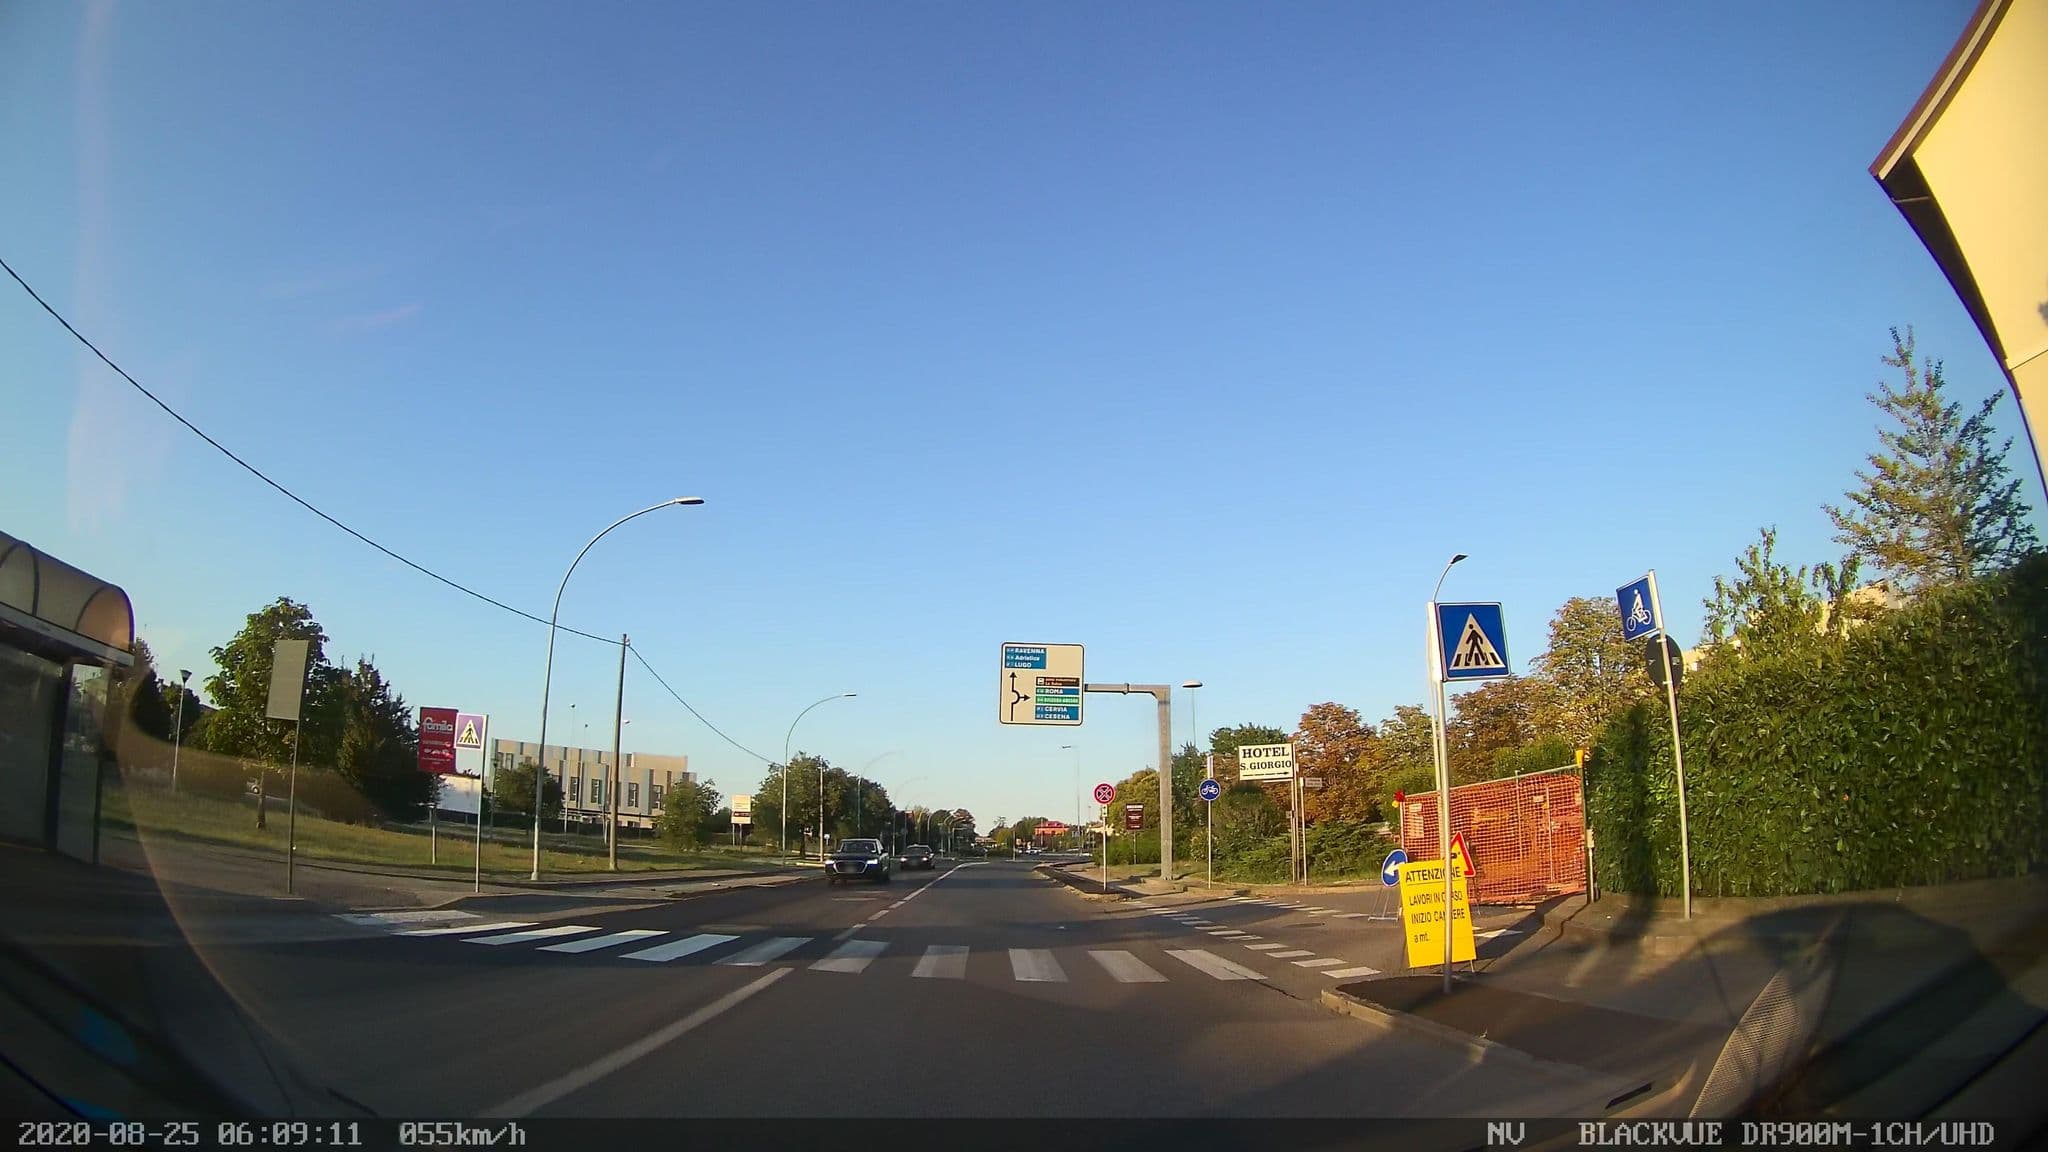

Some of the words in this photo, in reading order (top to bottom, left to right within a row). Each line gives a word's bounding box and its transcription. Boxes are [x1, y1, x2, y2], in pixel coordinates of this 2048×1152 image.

[424, 717, 454, 732] famila
[1242, 747, 1289, 758] HOTEL
[1240, 762, 1249, 770] S.
[1250, 760, 1292, 770] GIORGIO
[1409, 894, 1433, 906] LAVORI
[1434, 893, 1440, 903] IN
[1412, 912, 1432, 924] INIZIO
